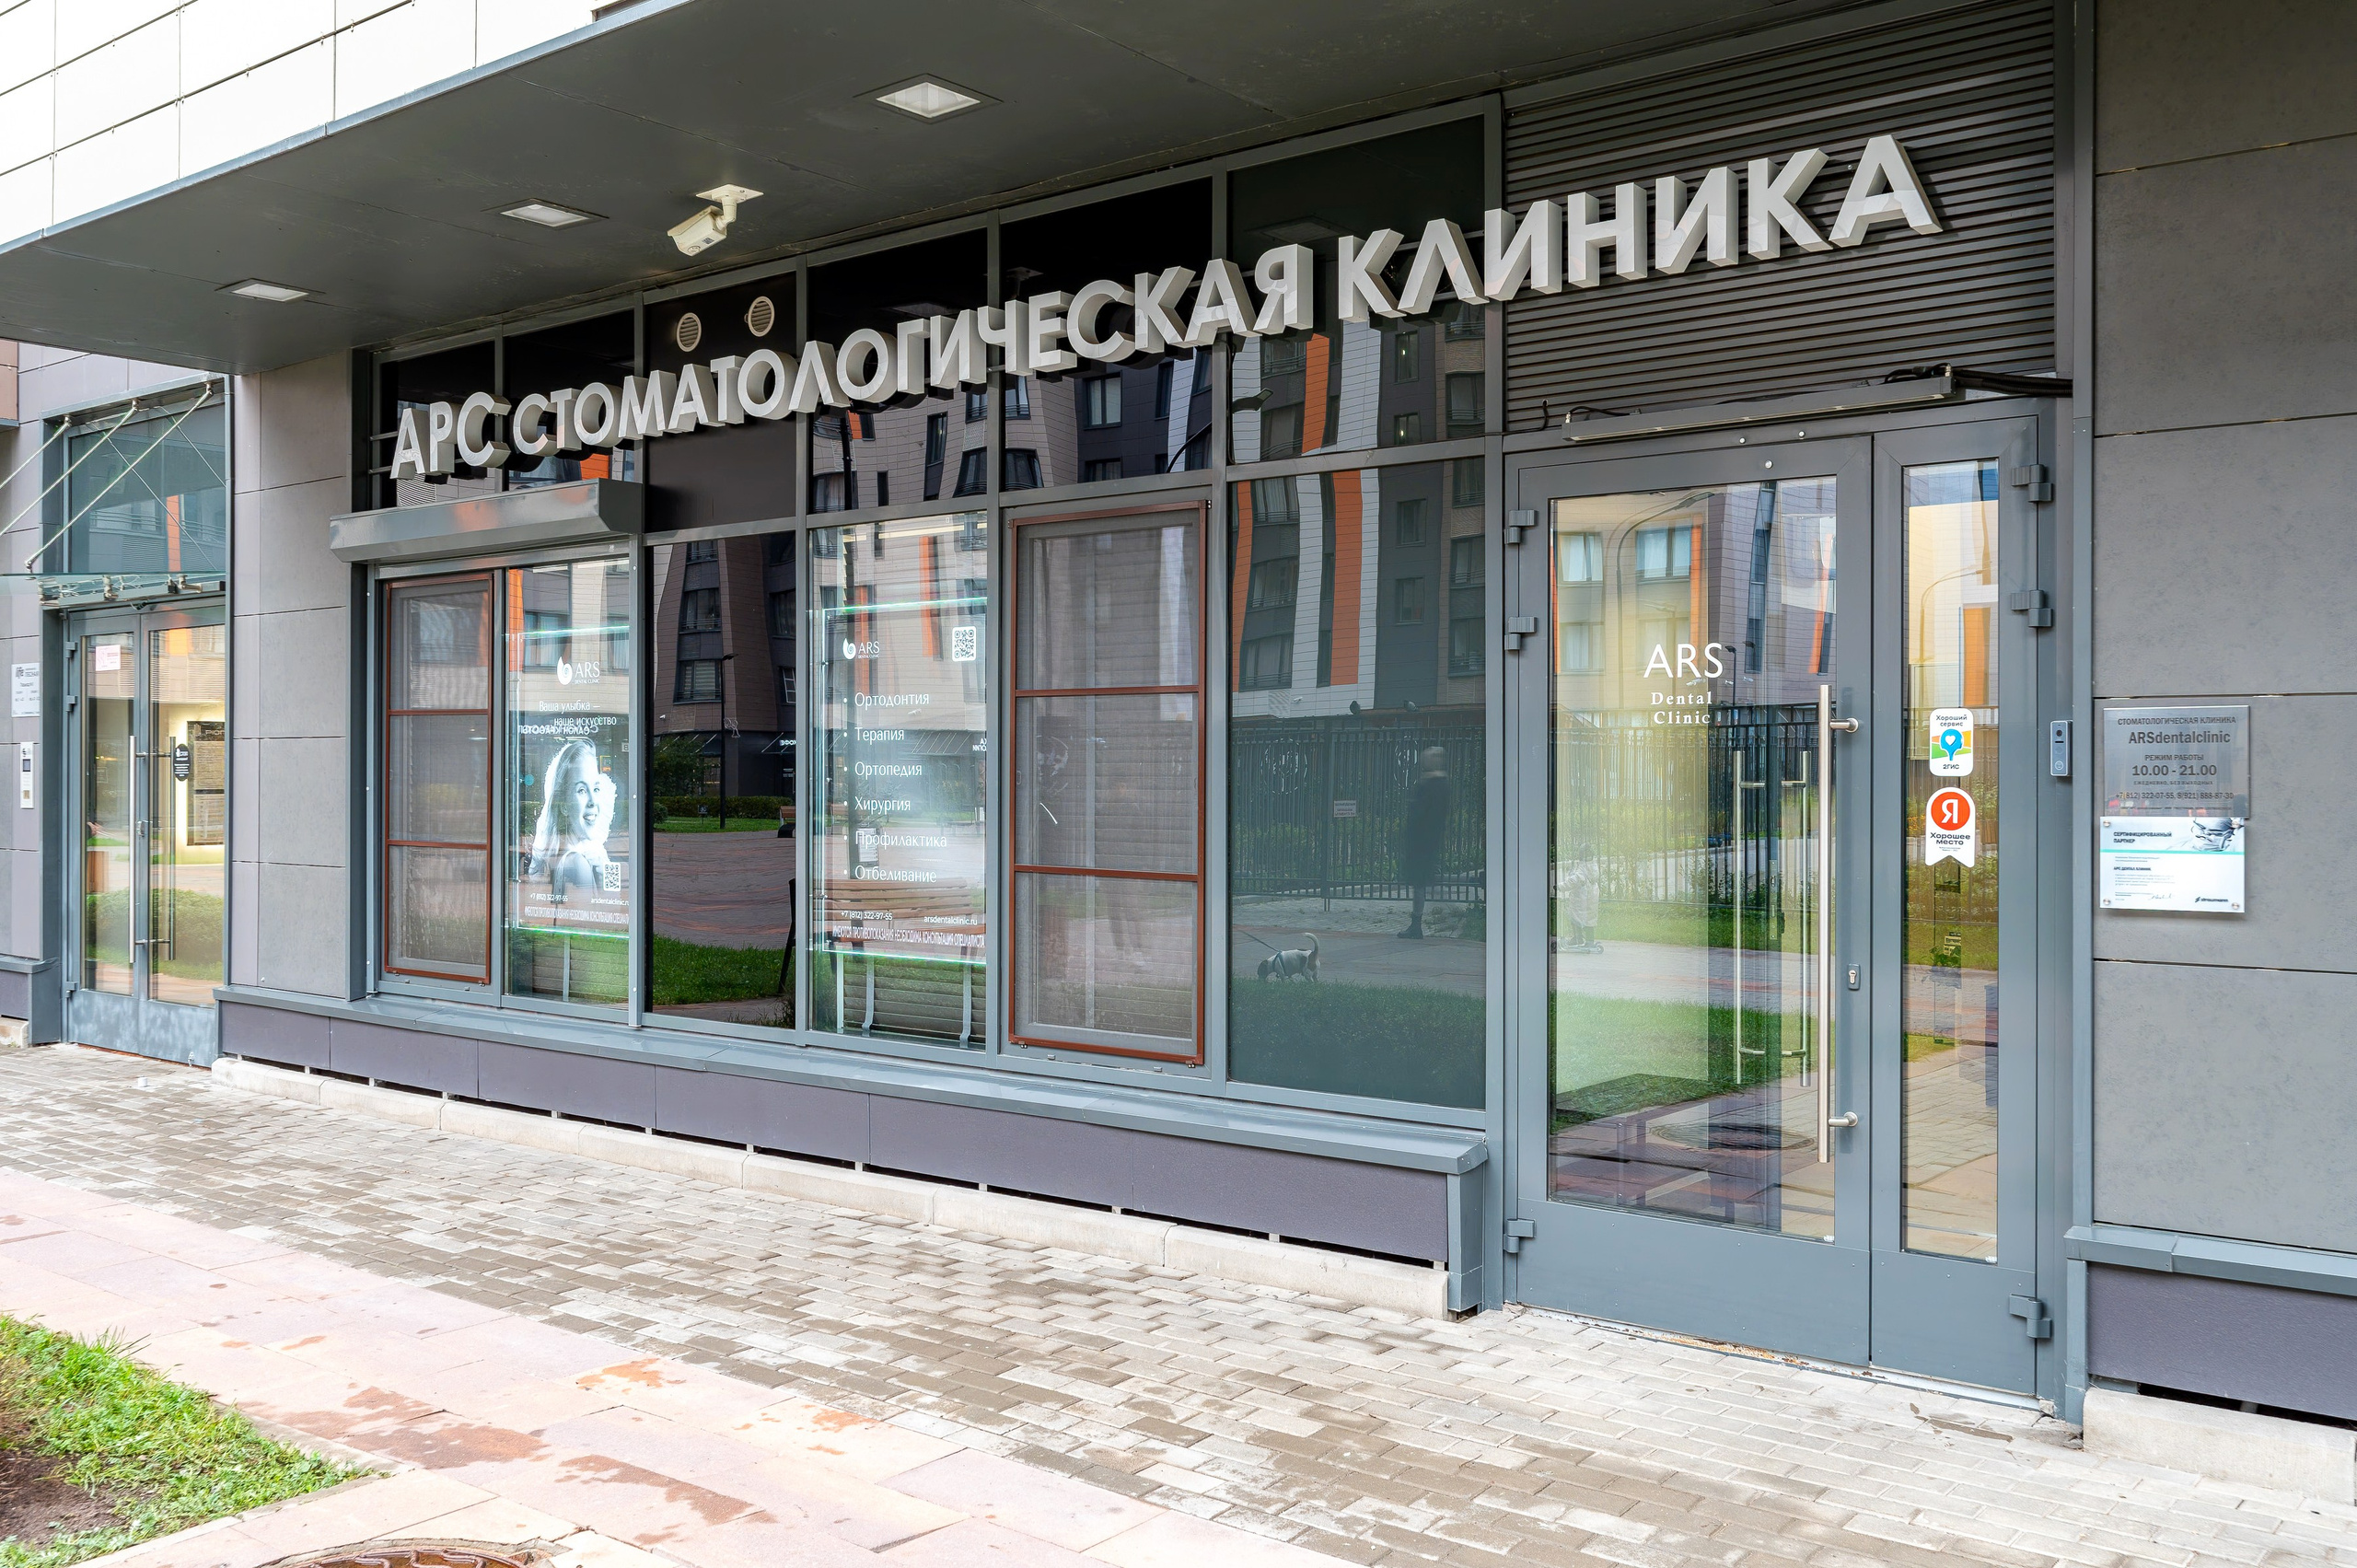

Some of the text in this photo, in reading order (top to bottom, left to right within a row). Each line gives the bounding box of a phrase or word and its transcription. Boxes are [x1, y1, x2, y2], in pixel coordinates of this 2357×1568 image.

[389, 134, 1944, 480] АРС СТОМАТОЛОГИЧЕСКАЯ КЛИНИКА
[858, 641, 880, 655] ARS
[1643, 643, 1724, 679] ARS
[575, 661, 600, 679] ARS
[854, 691, 930, 711] Ортодонтия
[1651, 691, 1713, 705] Dental
[539, 701, 559, 712] Ваша
[561, 699, 591, 714] улыбка
[554, 715, 617, 728] наше искусство
[1654, 710, 1711, 725] Clinic
[1936, 714, 1968, 723] Хороший
[2118, 716, 2199, 726] СТОМАТОЛОГИЧЕСКАЯ
[854, 726, 904, 743] Терапия
[2129, 730, 2231, 744] ARSdentalclinic
[854, 761, 923, 780] Ортопедия
[2132, 765, 2169, 776] 10.00
[2178, 764, 2217, 776] 21.00
[854, 796, 911, 815] Хирургия
[1942, 798, 1958, 824] Я
[854, 830, 947, 852] Профилактика
[854, 865, 937, 883] Отбеливание
[849, 911, 862, 921] (812)
[864, 912, 893, 921] 322-97-55
[923, 915, 978, 926] arsdentalclinic.ru
